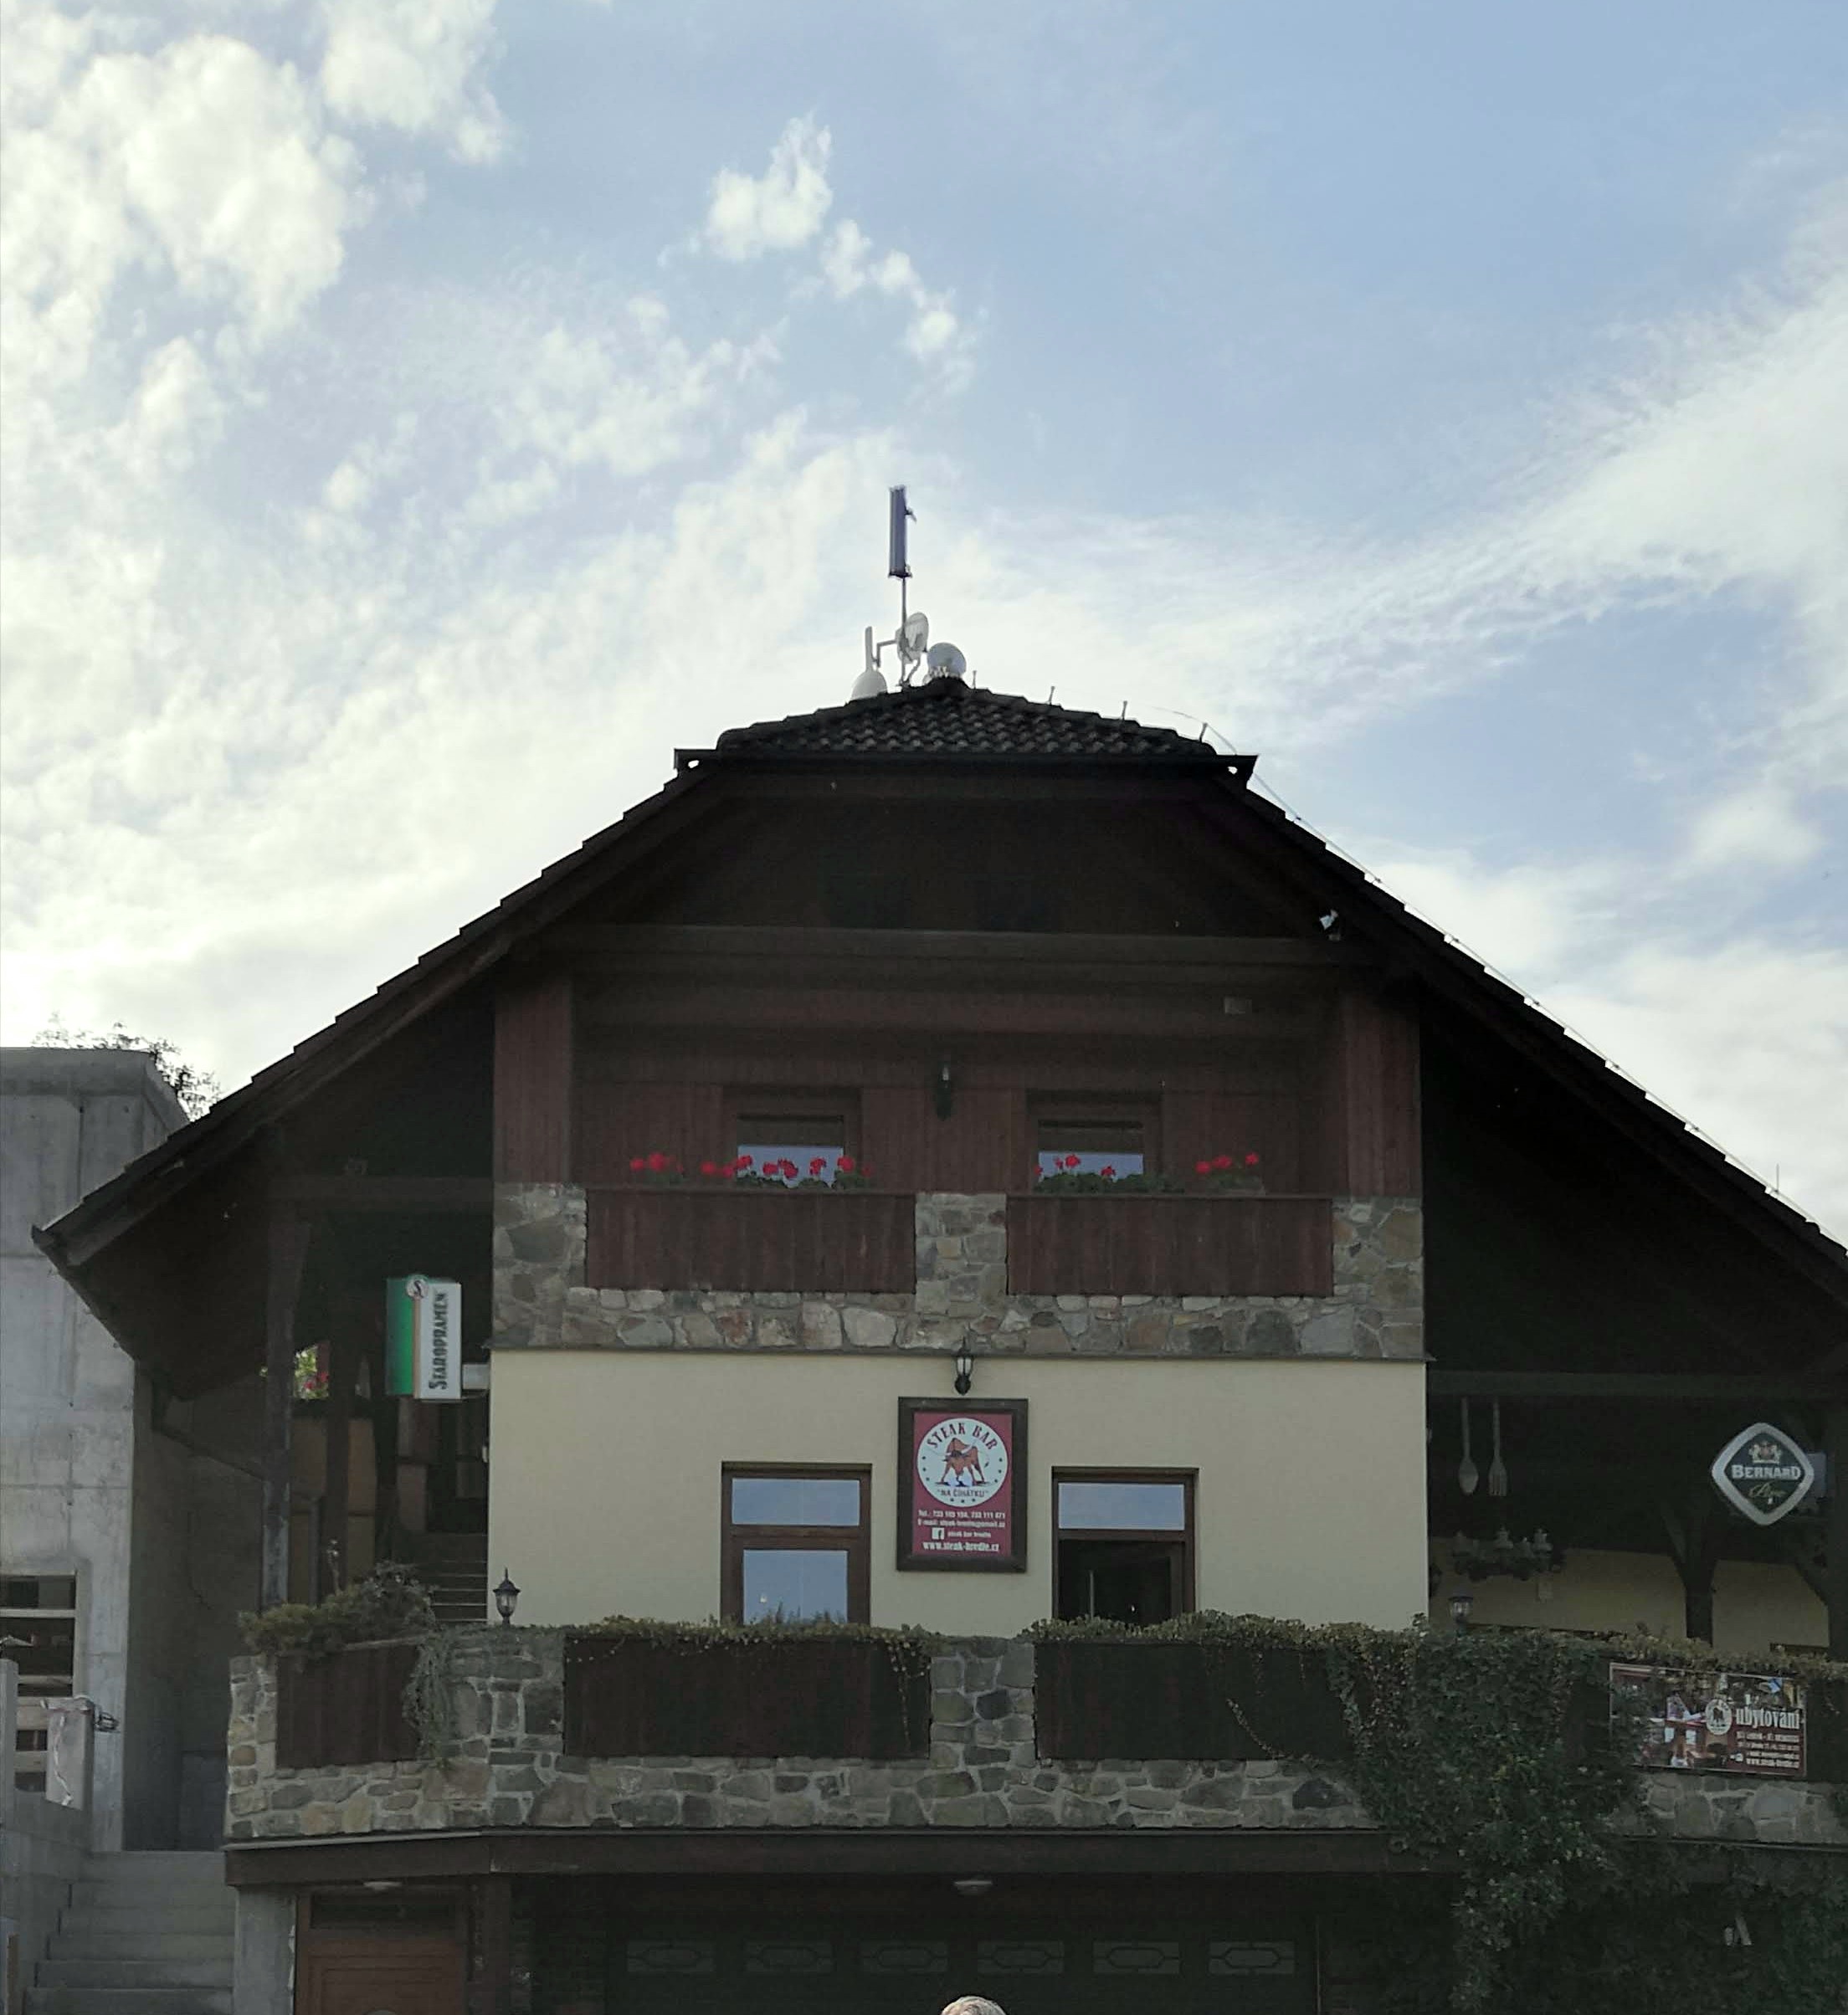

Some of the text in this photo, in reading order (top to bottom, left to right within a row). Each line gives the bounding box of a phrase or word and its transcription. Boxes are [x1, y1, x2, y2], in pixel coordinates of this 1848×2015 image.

[429, 1292, 449, 1391] STAROPRAMEN
[926, 1422, 998, 1450] STEAK BAR
[1731, 1464, 1801, 1480] BERNARD
